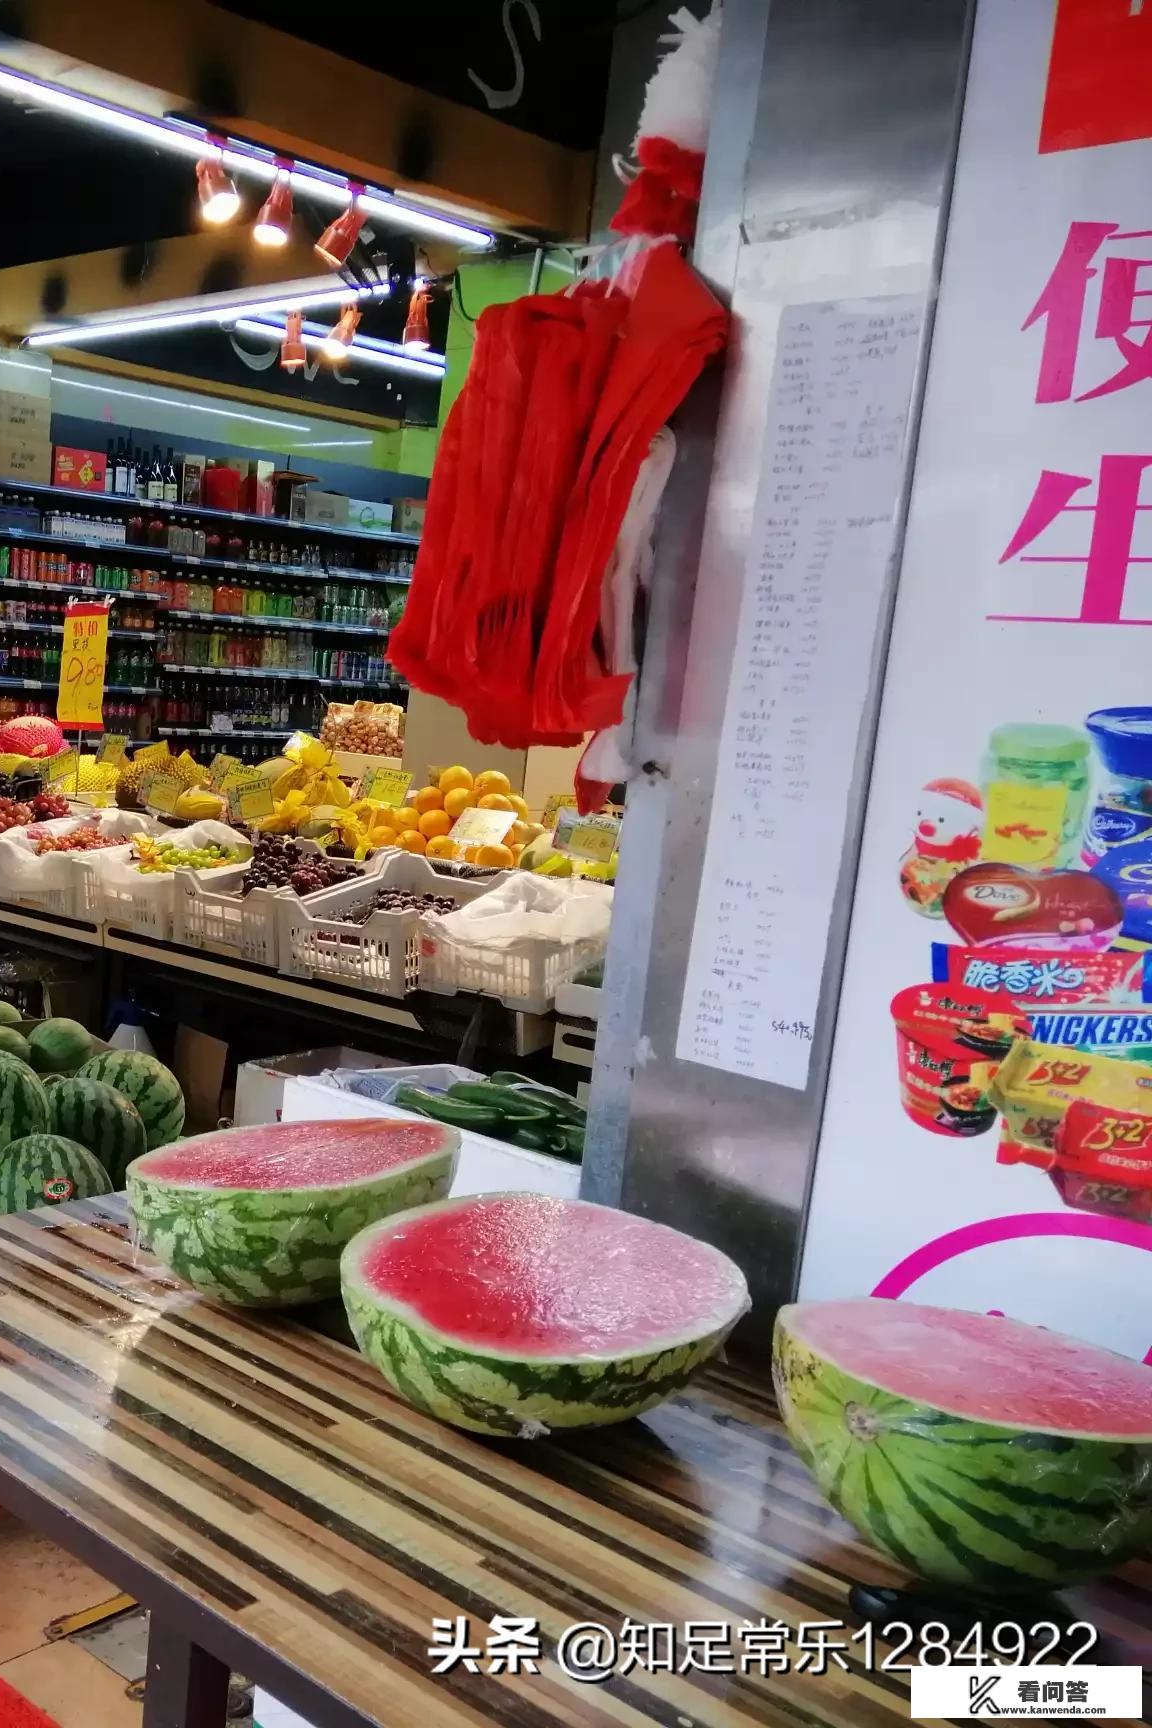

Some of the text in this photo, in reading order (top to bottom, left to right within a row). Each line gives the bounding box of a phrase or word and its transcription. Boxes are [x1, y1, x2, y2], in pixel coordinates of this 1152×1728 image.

[964, 958, 1084, 997] 脆香米
[1028, 1015, 1152, 1045] NICKERS
[1084, 1118, 1145, 1150] 3+2
